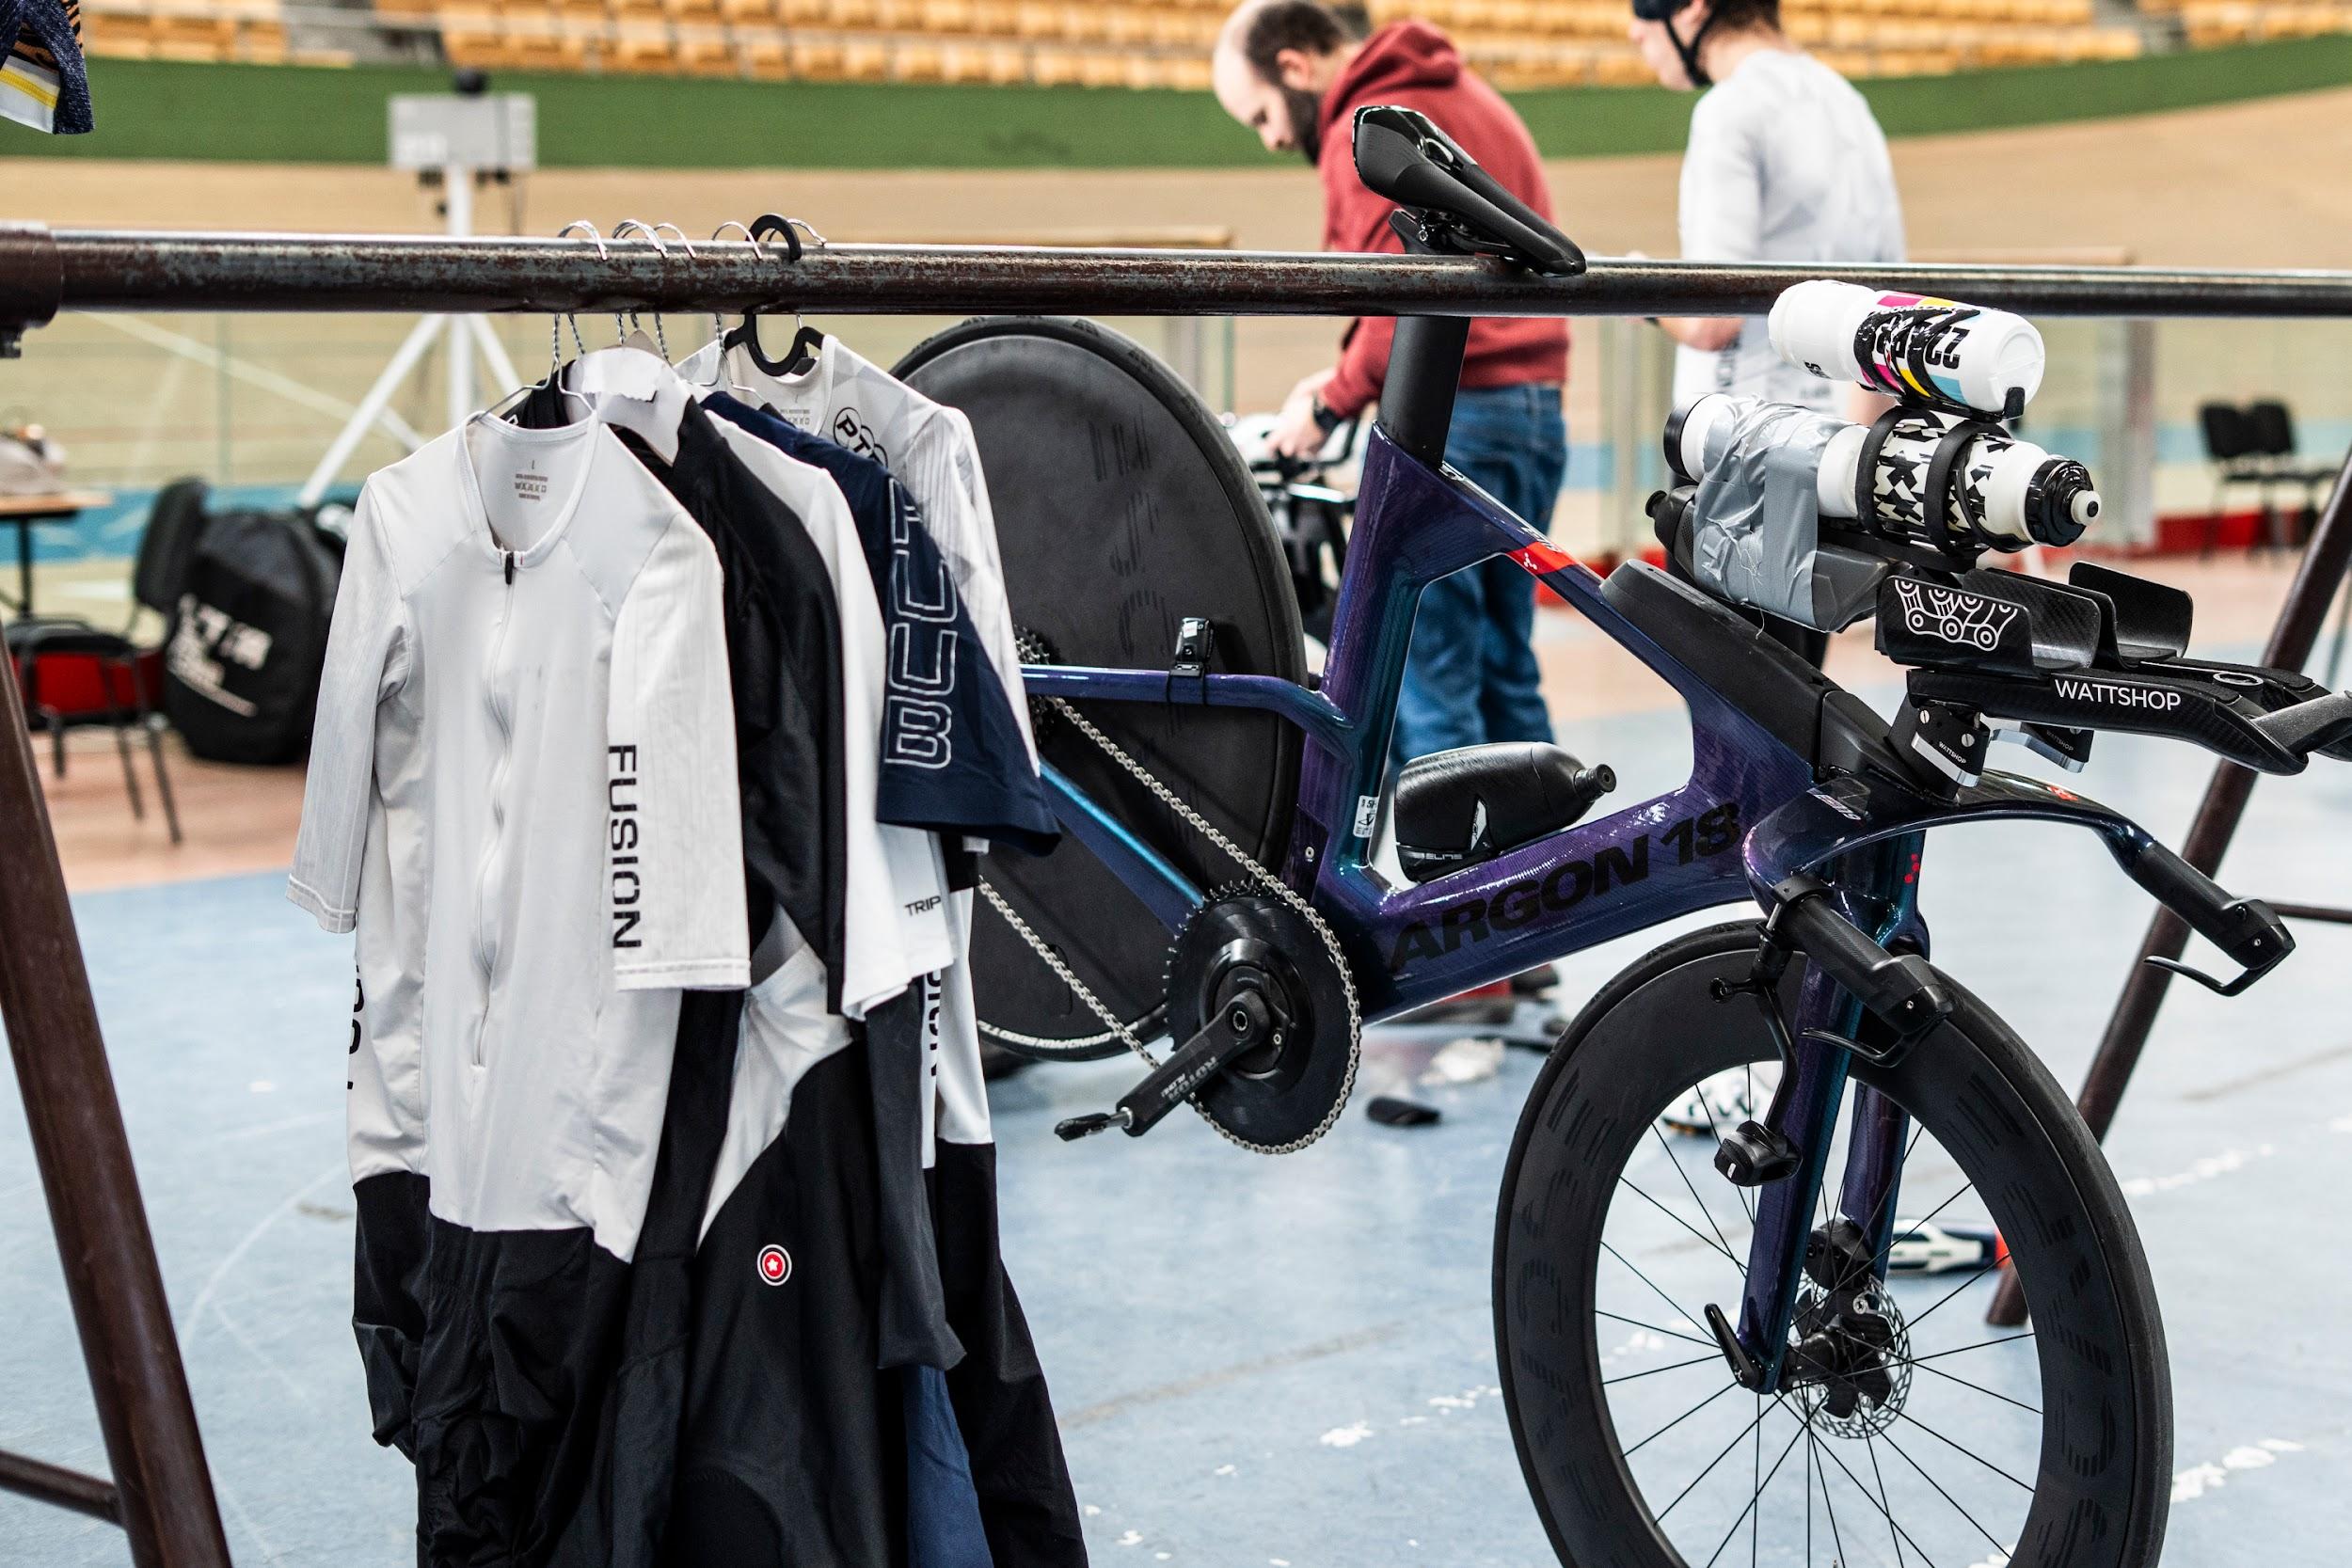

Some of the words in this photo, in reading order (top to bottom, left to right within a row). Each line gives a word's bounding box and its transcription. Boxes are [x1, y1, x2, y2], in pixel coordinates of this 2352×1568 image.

[2054, 678, 2182, 712] WATTSHOP
[1938, 740, 1967, 765] WATTSHOP
[608, 744, 642, 949] FUSION
[1391, 833, 1649, 973] ARGON
[1661, 801, 1740, 865] 18
[1167, 1055, 1219, 1103] ROTOR
